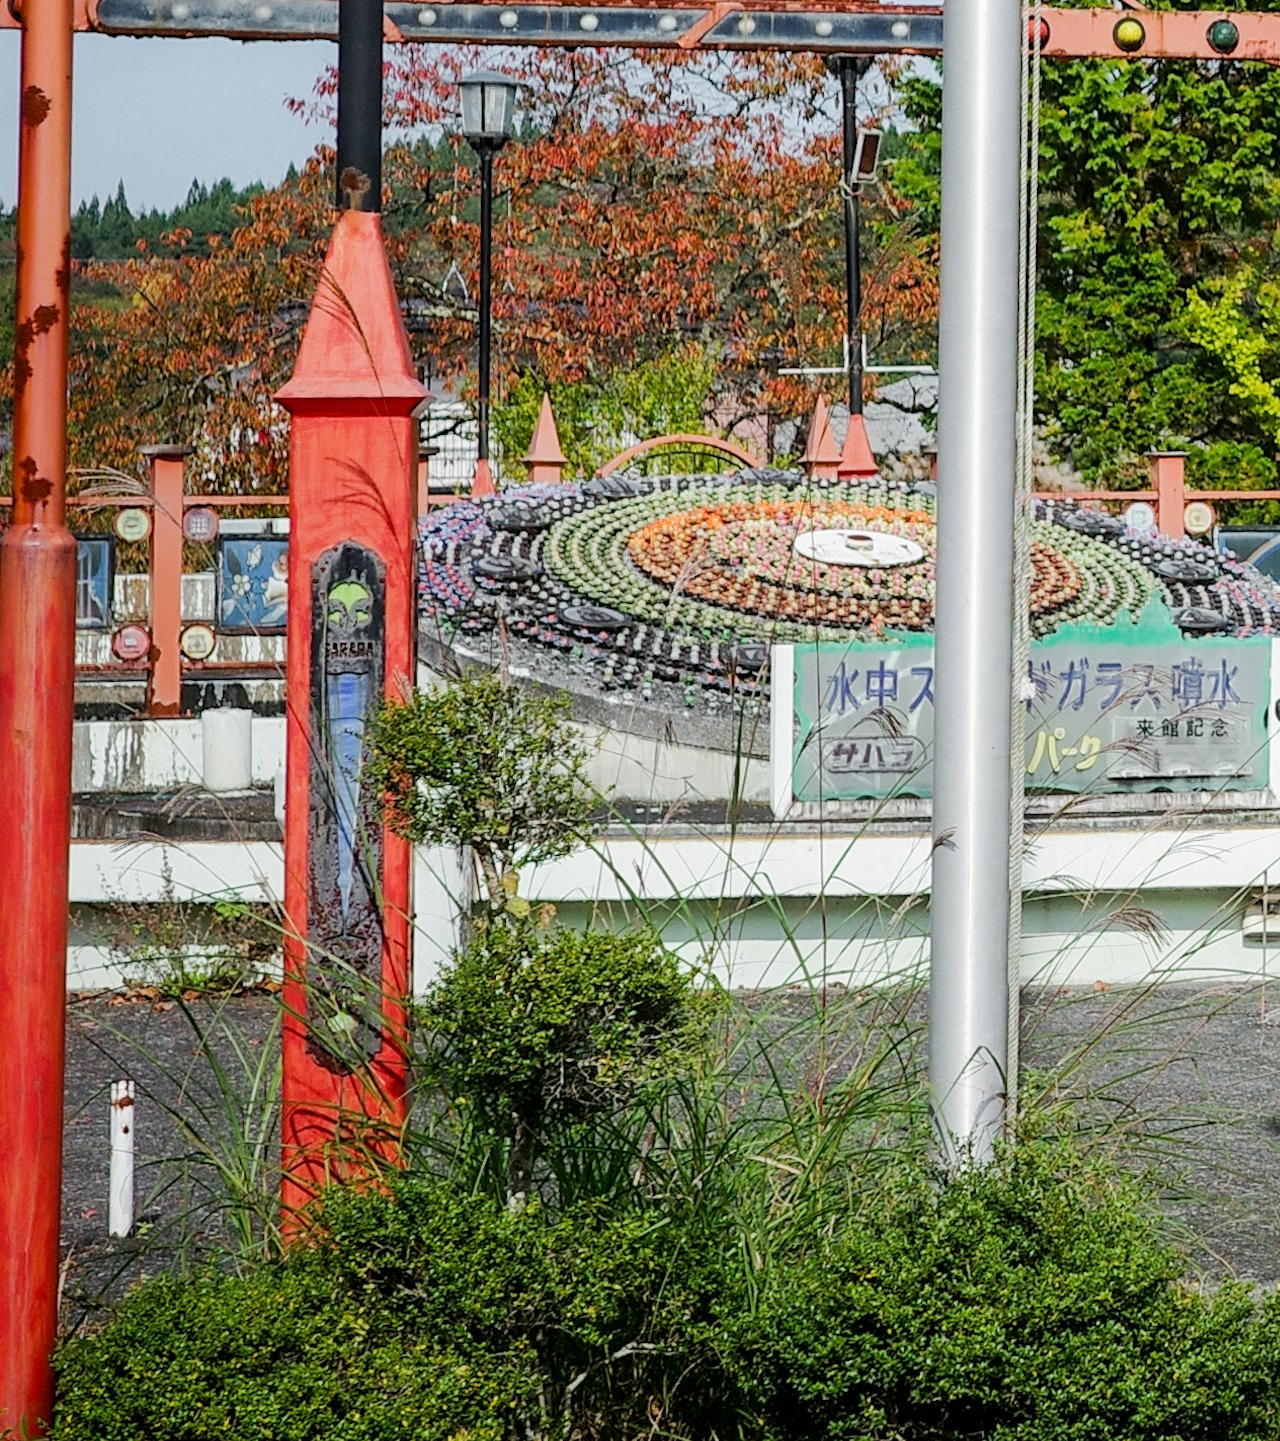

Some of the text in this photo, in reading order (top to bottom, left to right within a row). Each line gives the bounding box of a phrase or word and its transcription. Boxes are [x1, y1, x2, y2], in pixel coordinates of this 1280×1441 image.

[1136, 718, 1230, 739] 来館記念
[832, 727, 1101, 775] サハラ パーク
